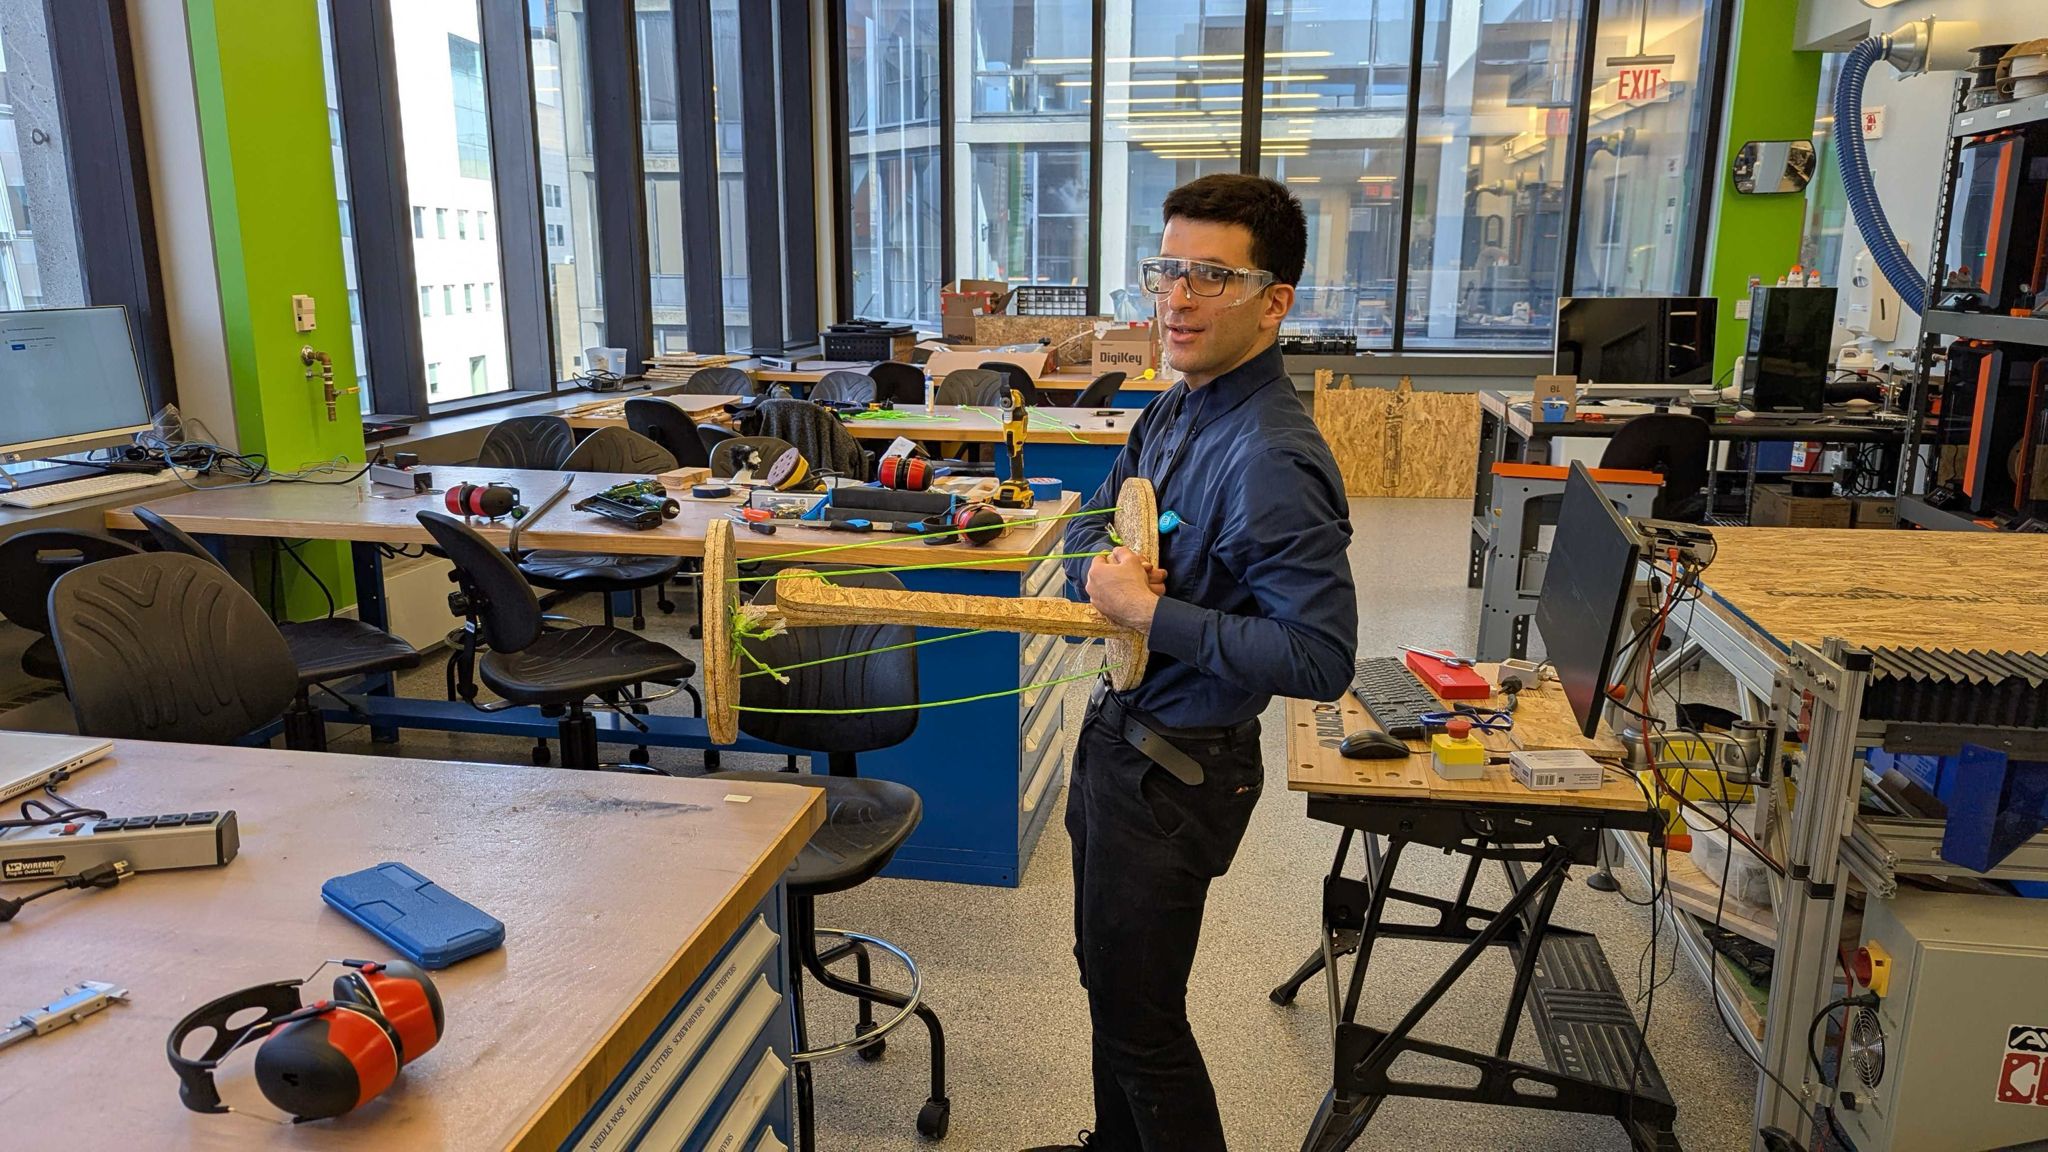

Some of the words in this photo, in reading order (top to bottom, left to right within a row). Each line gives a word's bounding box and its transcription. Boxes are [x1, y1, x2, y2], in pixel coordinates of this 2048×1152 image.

[1617, 69, 1661, 100] EXIT
[1100, 352, 1142, 365] DigiKey
[22, 861, 56, 869] WIREMO
[589, 1122, 613, 1152] NEEDLE
[610, 1104, 627, 1126] NOSE
[626, 1072, 653, 1105] DIAGONAL
[650, 1045, 673, 1074] CUTTERS
[672, 1004, 706, 1045] SCREWDRIVERS
[704, 988, 718, 1003] WIRE
